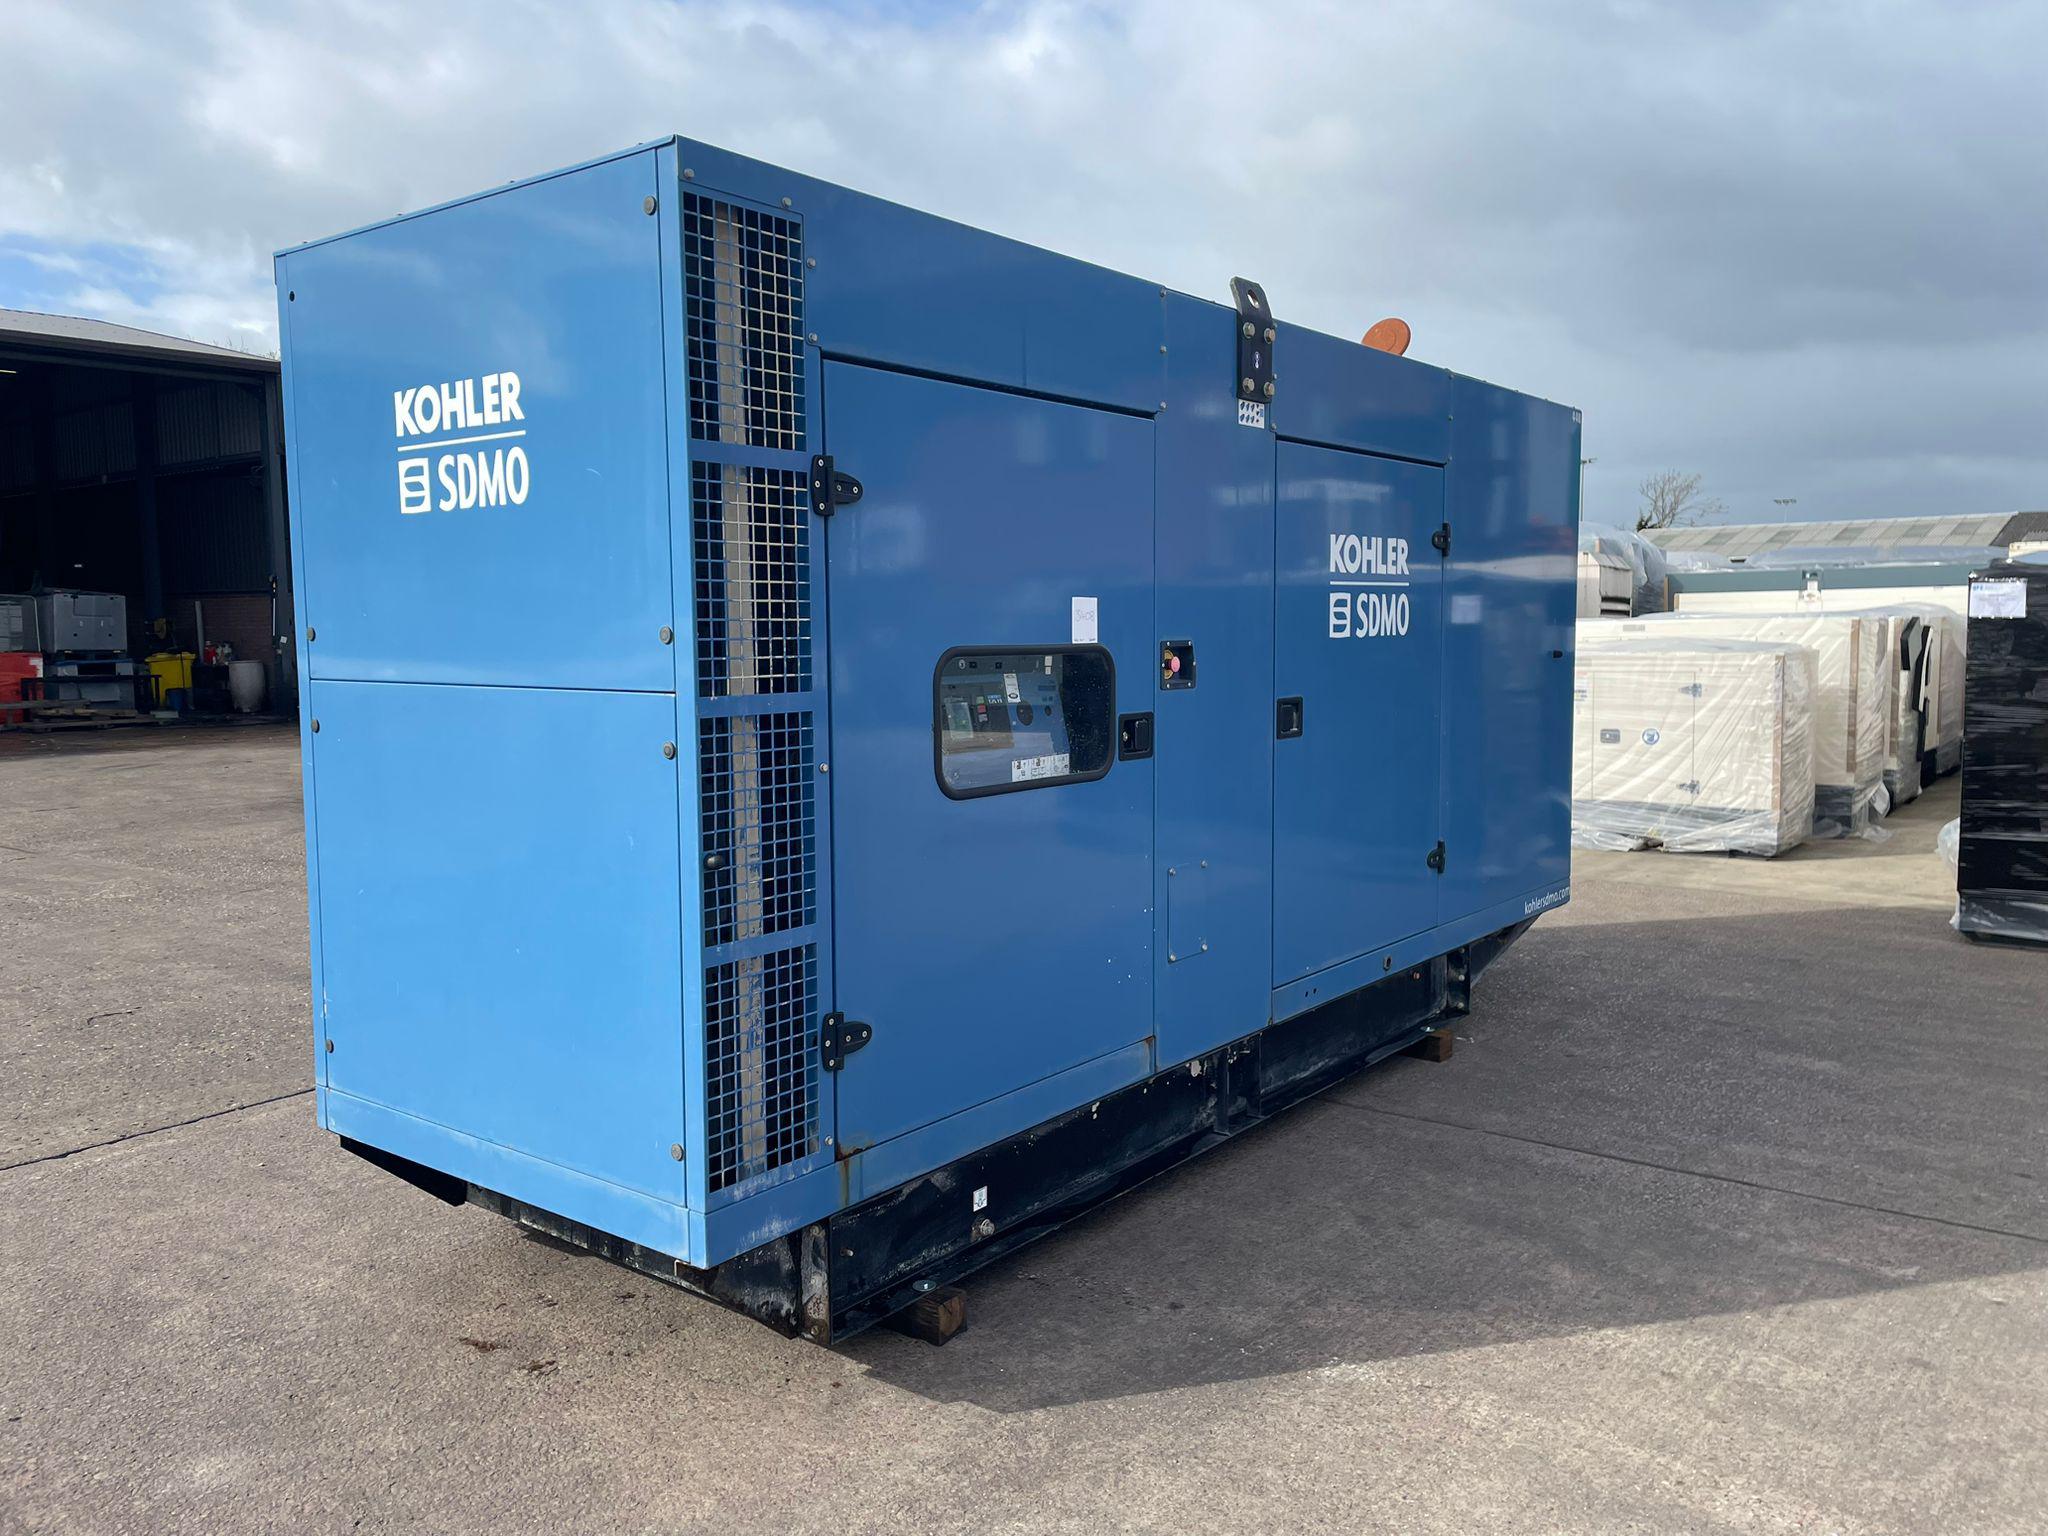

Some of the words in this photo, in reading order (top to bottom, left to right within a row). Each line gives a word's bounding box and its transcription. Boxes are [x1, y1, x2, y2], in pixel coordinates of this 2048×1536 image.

[394, 371, 525, 437] KOHLER
[437, 446, 529, 512] SDMO
[1329, 533, 1410, 575] KOHLER
[1355, 592, 1410, 638] SDMO
